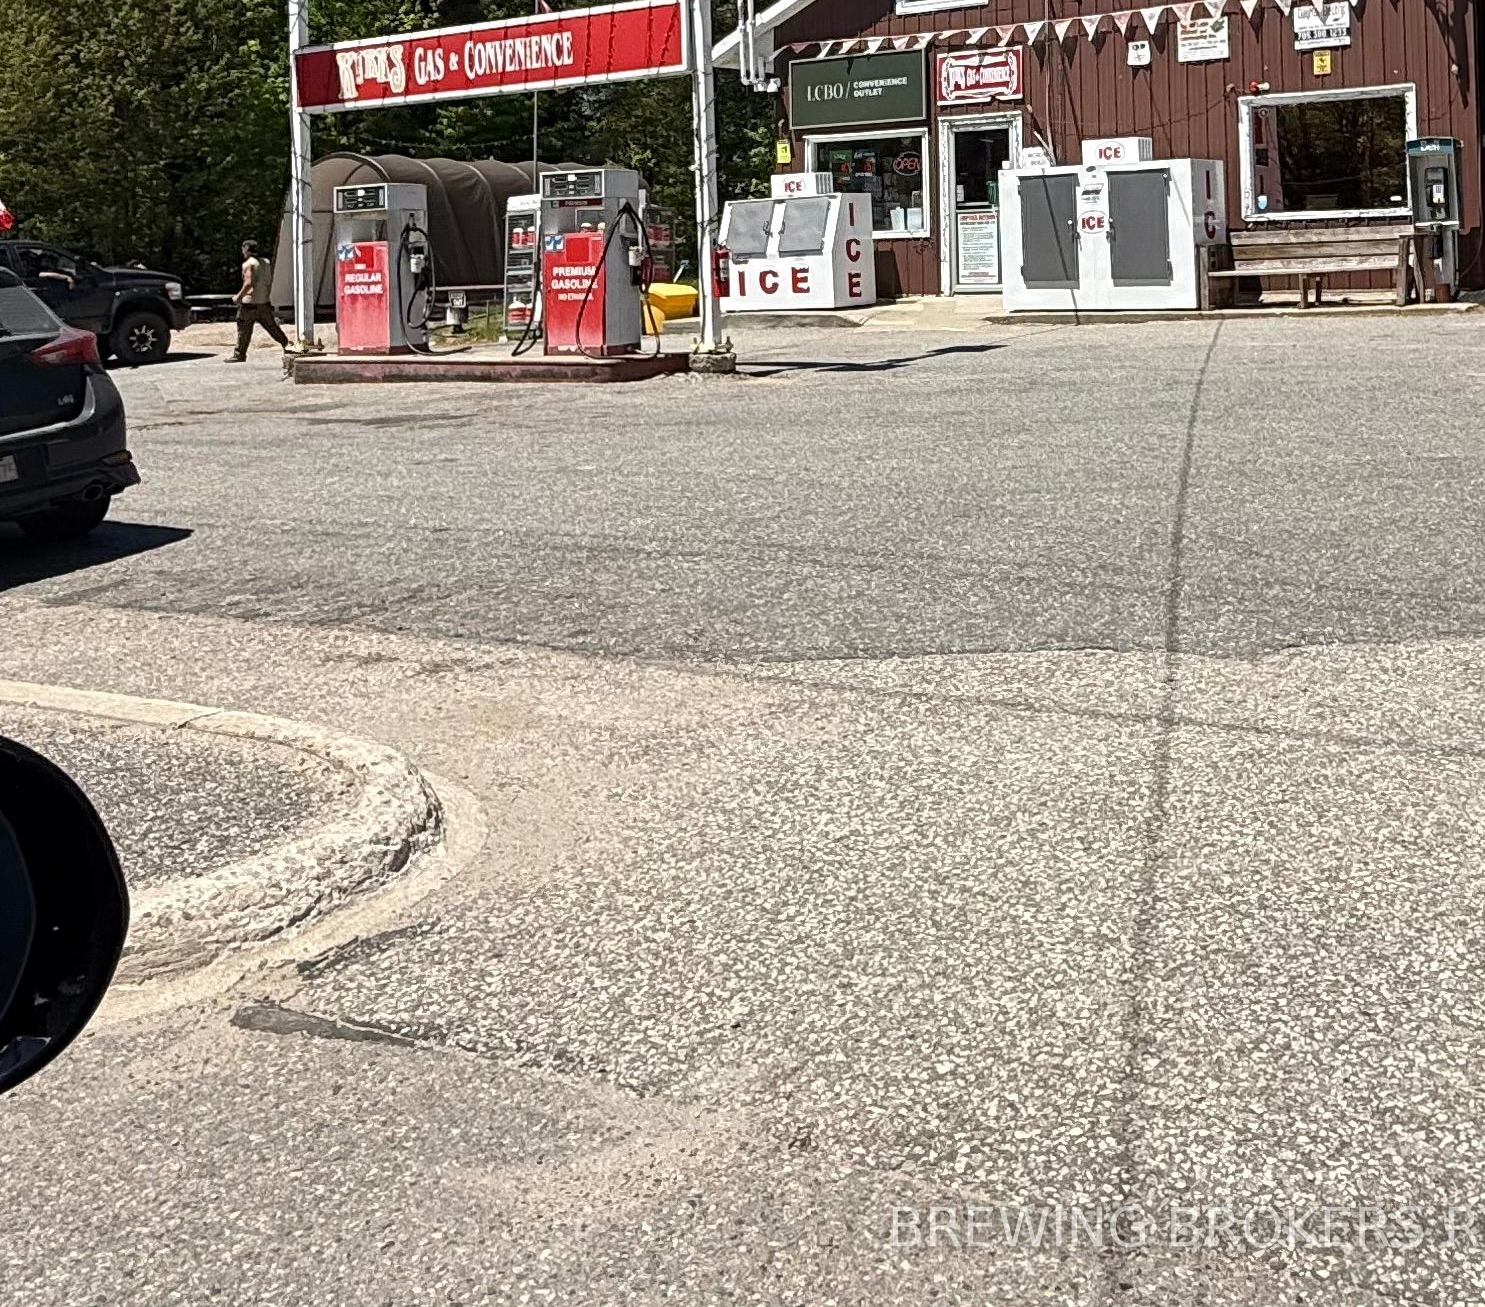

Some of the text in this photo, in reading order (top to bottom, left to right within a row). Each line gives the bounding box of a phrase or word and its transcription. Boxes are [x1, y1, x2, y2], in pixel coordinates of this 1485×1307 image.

[449, 51, 459, 71] &
[464, 31, 574, 80] CONVENIENCE
[853, 76, 908, 89] CONVENIENCE
[807, 82, 844, 102] LCBO
[853, 87, 883, 98] OUTLET
[1098, 146, 1122, 160] ICE
[896, 157, 921, 170] OPEN
[784, 180, 803, 193] ICE
[1081, 215, 1105, 231] ICE
[846, 202, 862, 298] ICE
[344, 272, 382, 283] REGULAR
[552, 266, 598, 277] PREMIUM
[551, 278, 598, 291] GASOLINE
[738, 266, 811, 298] ICE
[343, 284, 384, 295] GASOLINE
